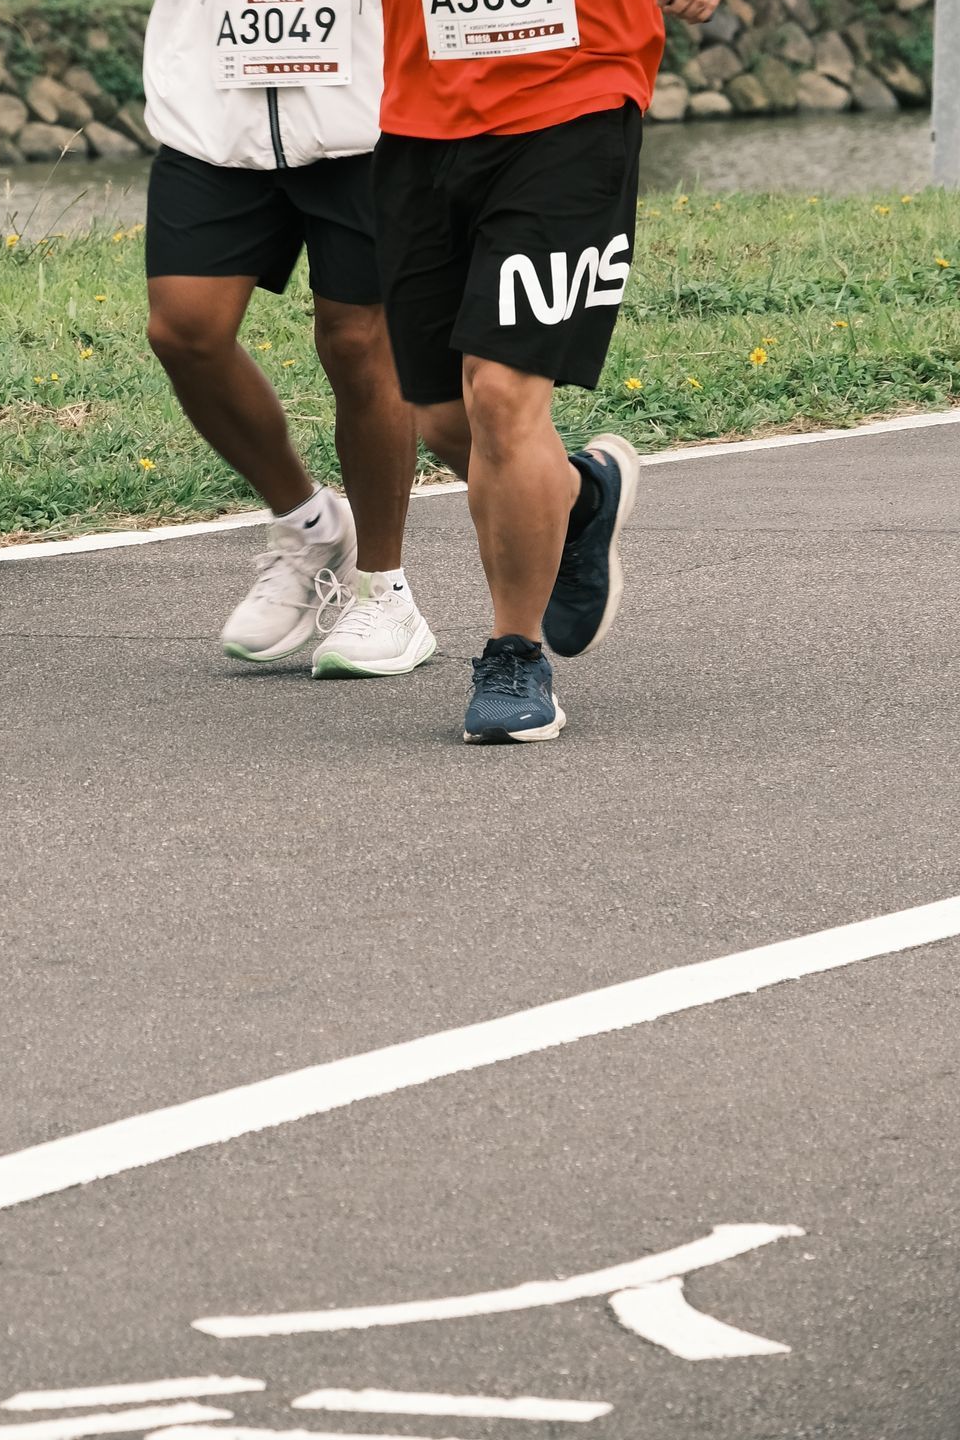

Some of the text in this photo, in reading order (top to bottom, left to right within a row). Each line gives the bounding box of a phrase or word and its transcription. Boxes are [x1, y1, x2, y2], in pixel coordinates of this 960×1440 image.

[217, 7, 335, 46] A3049
[497, 33, 504, 41] A
[508, 32, 515, 40] B
[518, 30, 525, 39] C
[529, 29, 536, 37] D
[539, 28, 546, 36] E
[549, 26, 555, 34] F
[498, 233, 630, 326] NAS
